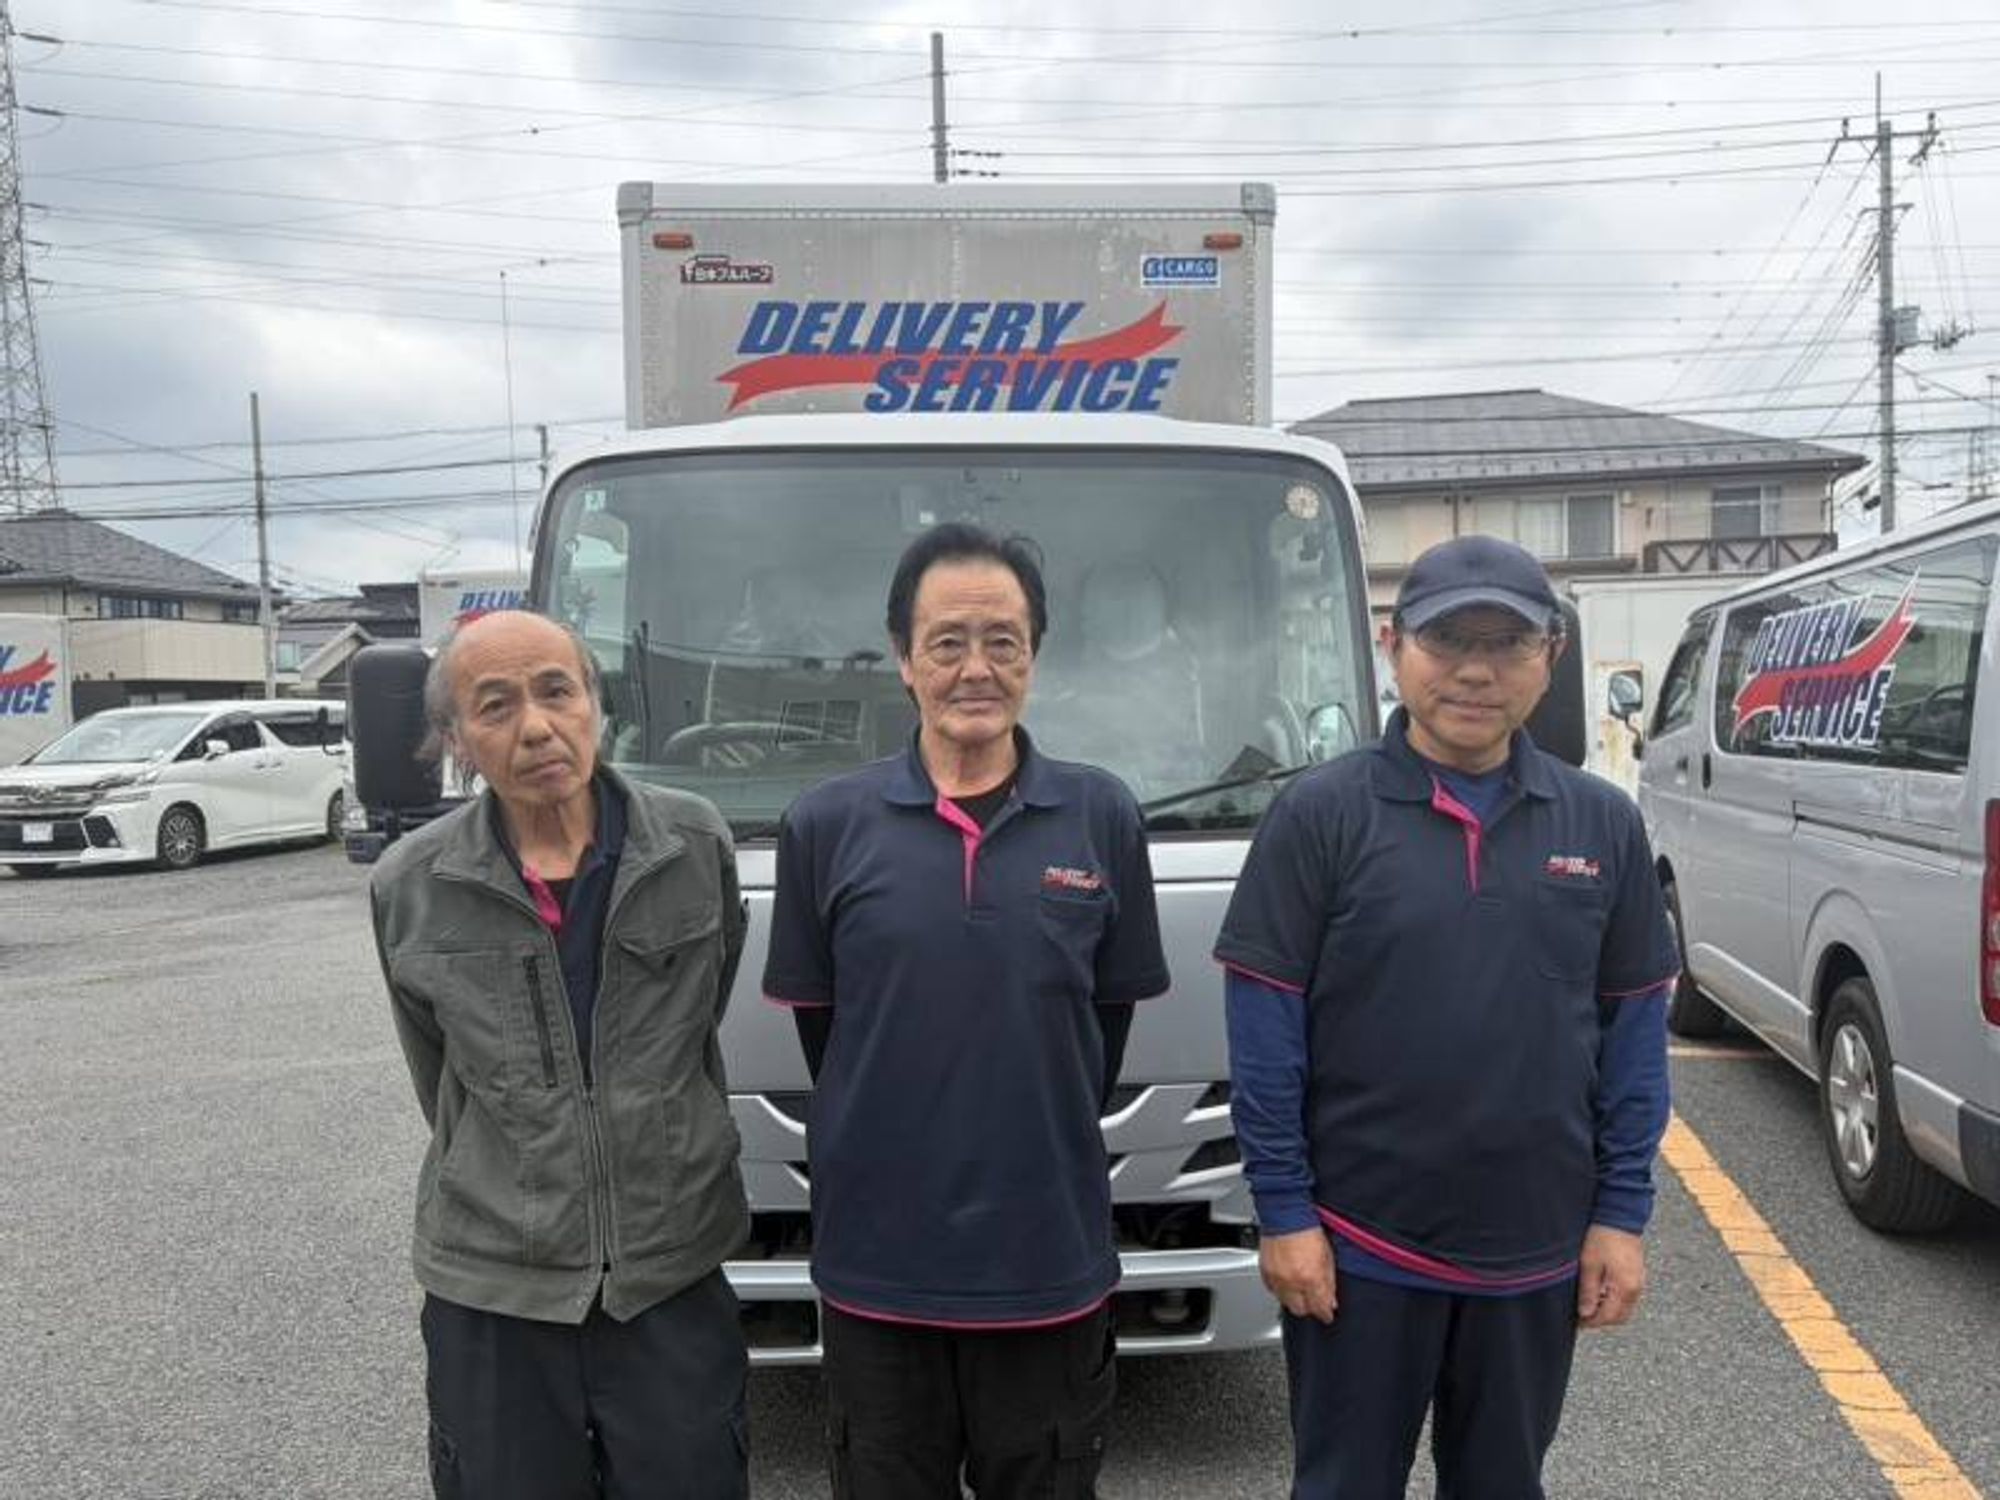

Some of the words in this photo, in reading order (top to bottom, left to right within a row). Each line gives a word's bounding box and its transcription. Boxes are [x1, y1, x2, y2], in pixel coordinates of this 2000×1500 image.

[738, 300, 1084, 356] DELIVERY
[864, 357, 1178, 413] SERVICE
[1747, 593, 1869, 674] DELIVERY
[0, 681, 55, 715] ICE
[1771, 667, 1895, 743] SERVICE
